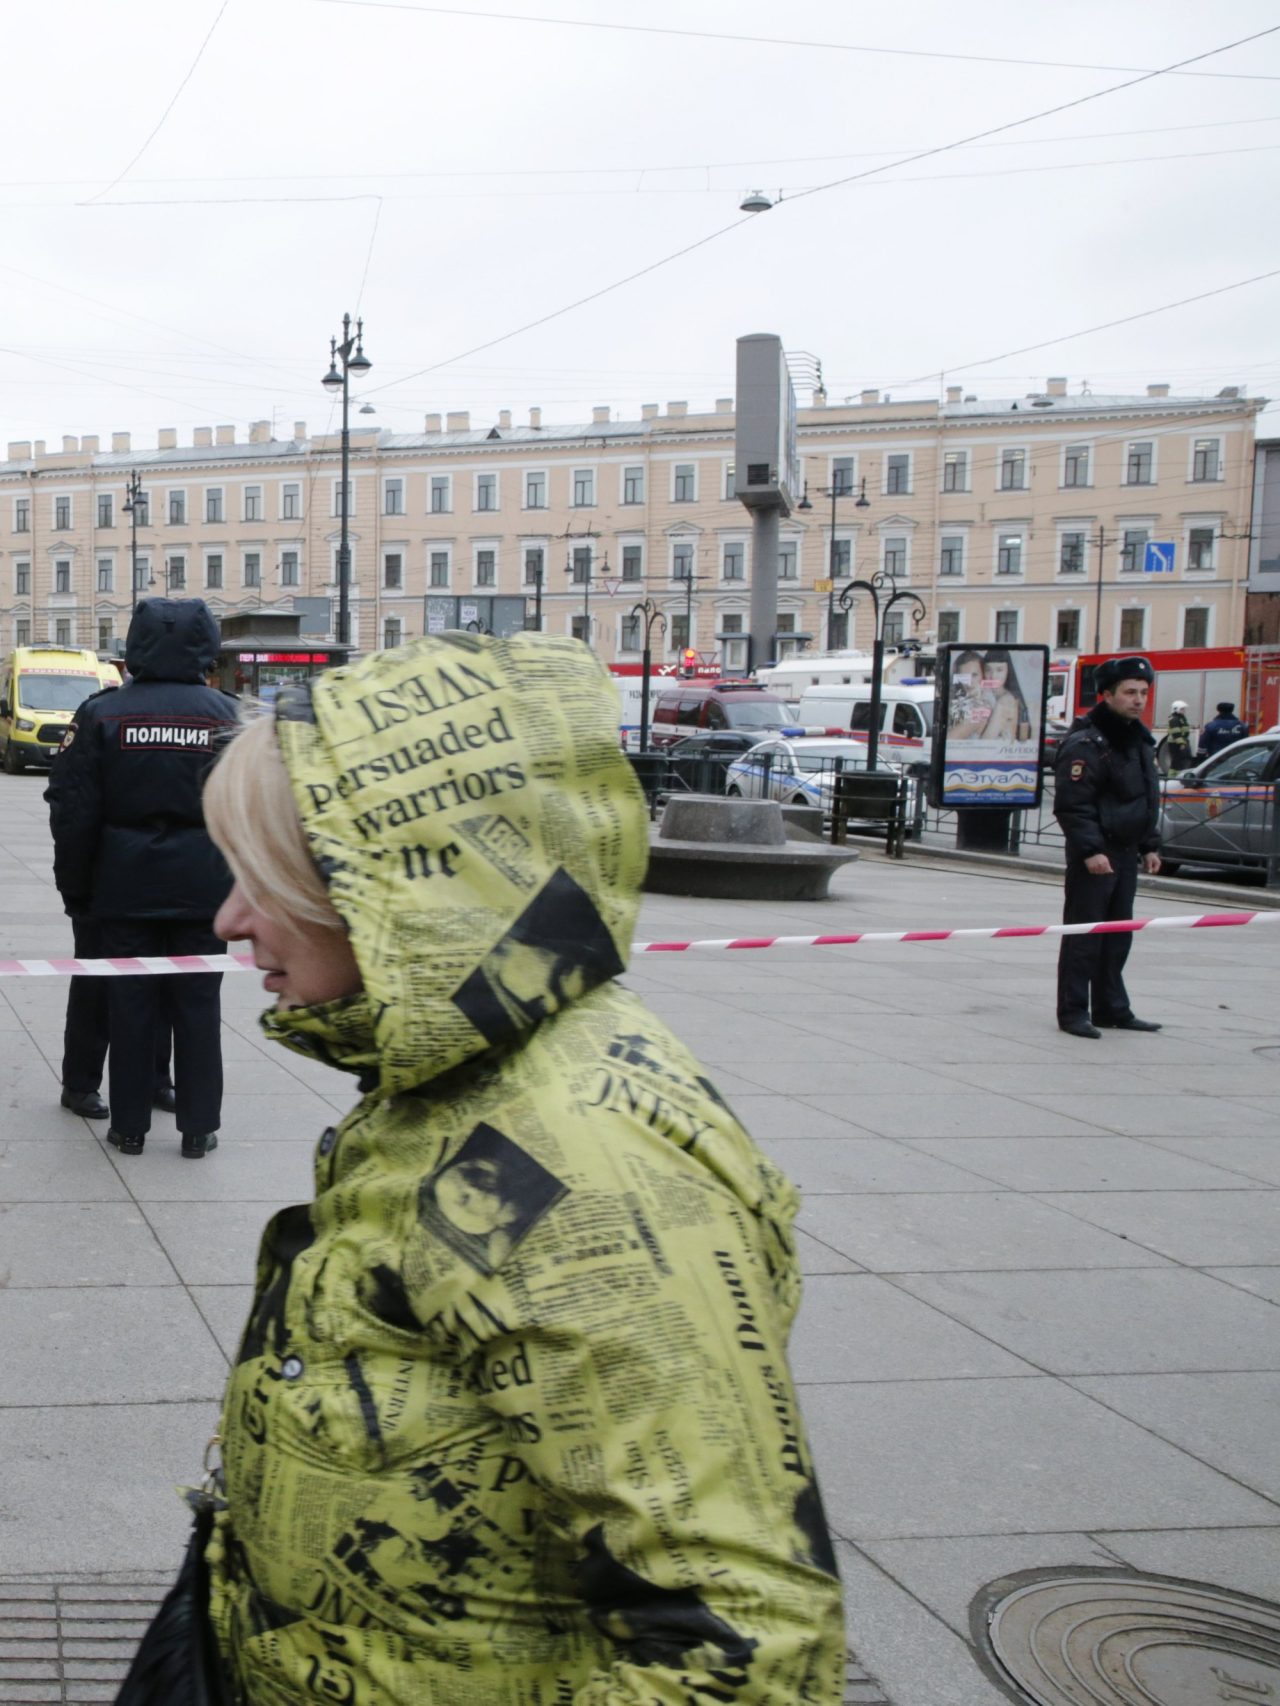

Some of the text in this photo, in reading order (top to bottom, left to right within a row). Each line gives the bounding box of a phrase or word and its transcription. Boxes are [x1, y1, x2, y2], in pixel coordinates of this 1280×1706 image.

[126, 727, 209, 746] ПОЛИЦИЯ
[306, 706, 514, 815] persuaded
[352, 761, 527, 841] warriors
